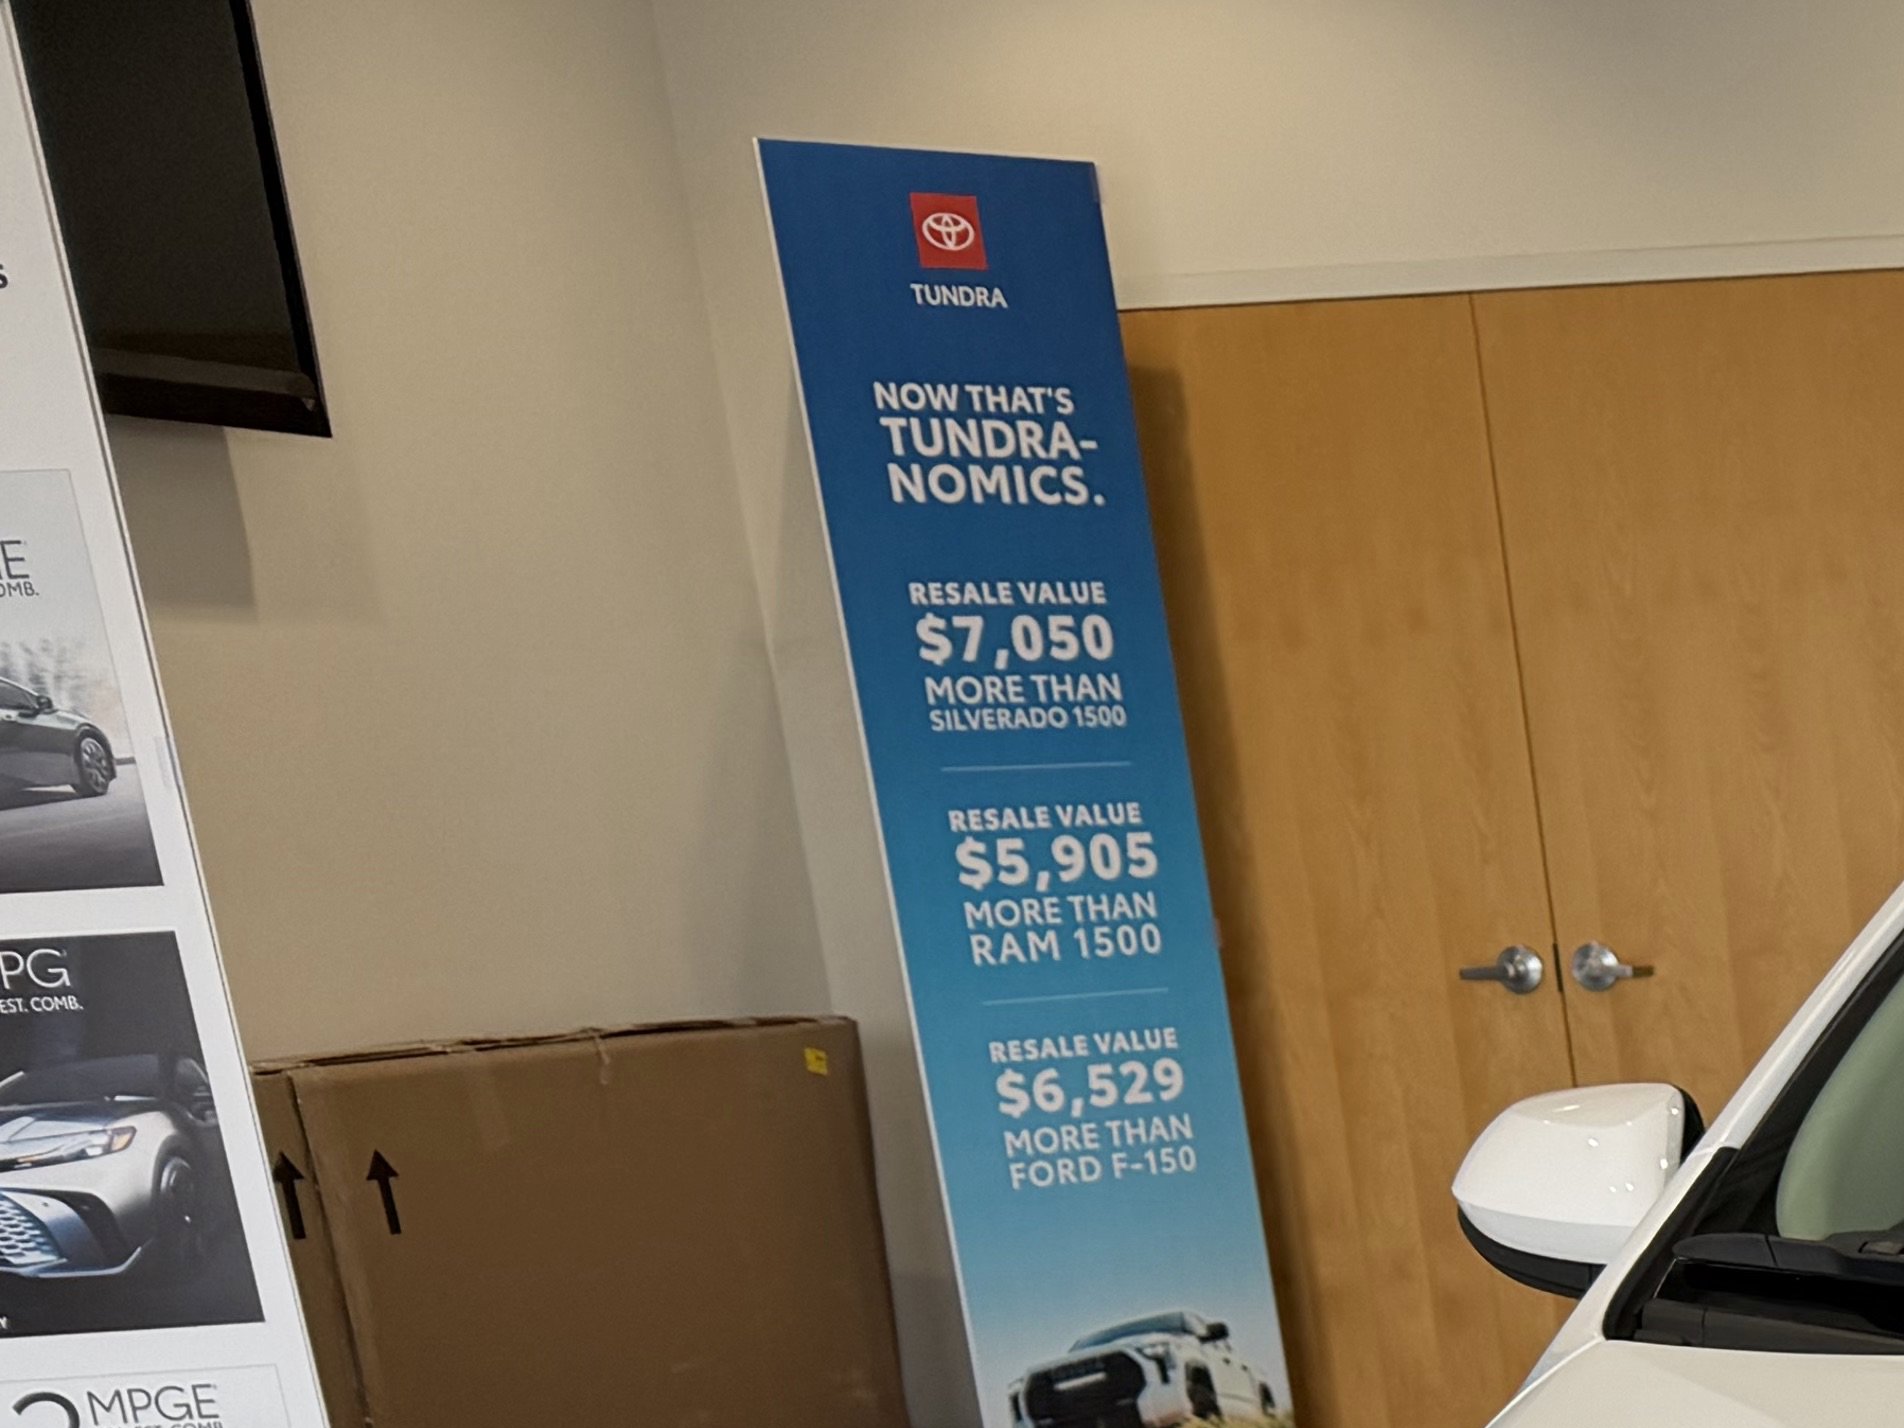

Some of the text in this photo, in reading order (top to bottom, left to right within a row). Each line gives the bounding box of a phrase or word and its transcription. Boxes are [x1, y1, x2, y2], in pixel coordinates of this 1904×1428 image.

[910, 283, 1008, 308] TUNDRA
[873, 382, 1075, 415] NOW THAT'S
[879, 416, 1098, 461] TUNDRA-
[887, 462, 1105, 506] NOMICS.
[908, 581, 1107, 605] RESALE VALUE
[915, 612, 1113, 670] $7,050
[924, 673, 1123, 705] MORE THAN
[929, 705, 1127, 731] SILVERADO 1500
[948, 802, 1143, 832] RESALE VALUE
[955, 831, 1158, 892] $5,905
[963, 891, 1158, 930] MORE THAN
[970, 923, 1160, 966] RAM 1500
[0, 949, 71, 989] PG
[30, 995, 84, 1012] COMB.
[988, 1027, 1178, 1063] RESALE VALUE
[996, 1057, 1183, 1119] $6,529
[1003, 1113, 1193, 1158] MORE THAN
[1009, 1145, 1196, 1190] FORD F-150
[86, 1384, 219, 1426] MPGE
